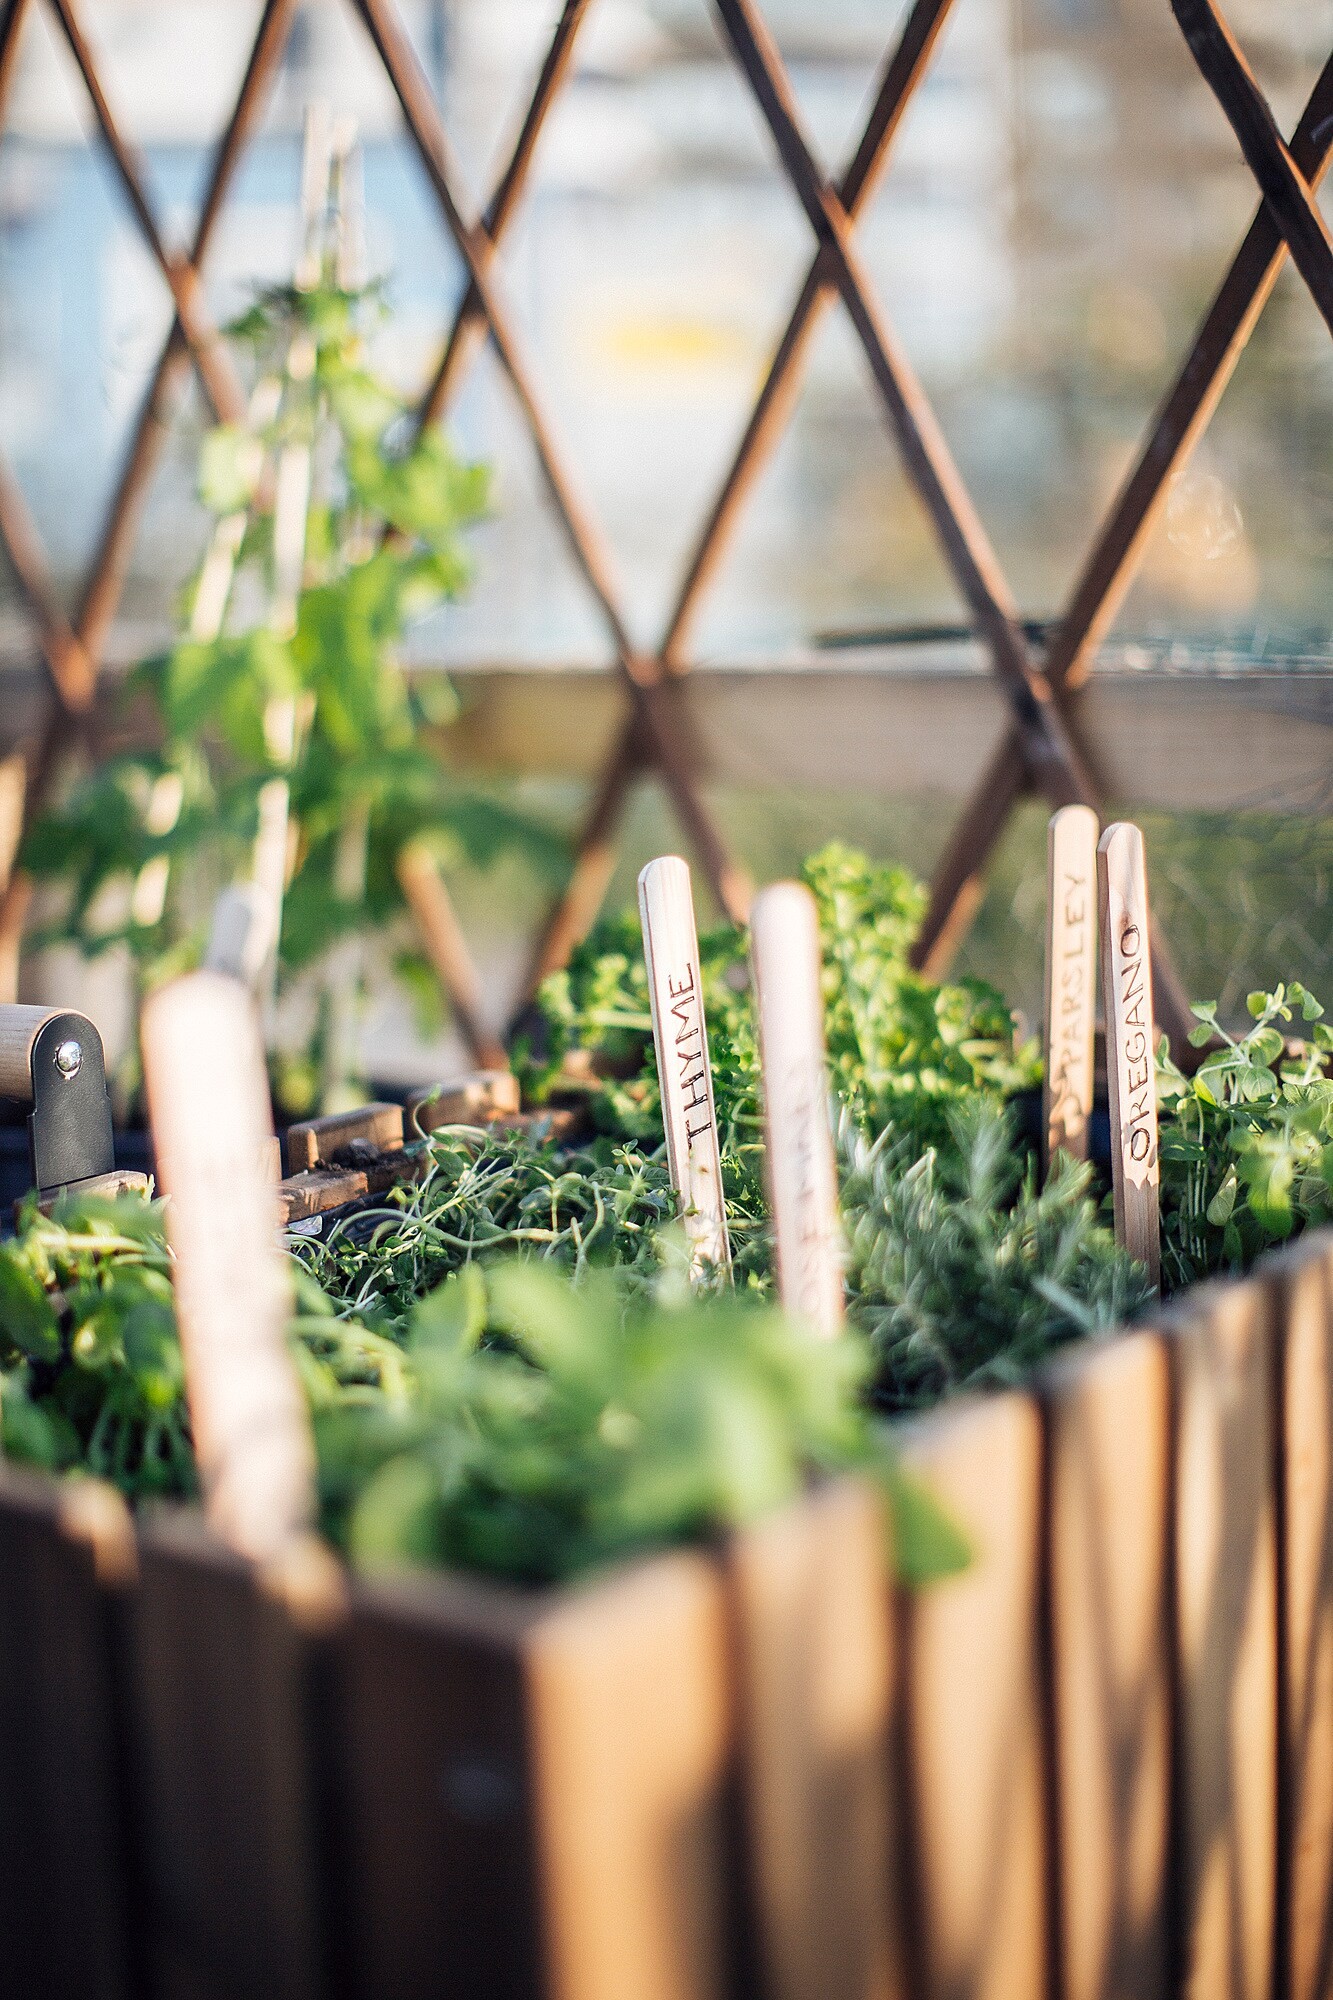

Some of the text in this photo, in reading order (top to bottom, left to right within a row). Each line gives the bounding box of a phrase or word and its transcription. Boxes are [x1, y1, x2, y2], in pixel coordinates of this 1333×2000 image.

[669, 962, 712, 1150] THYME
[1060, 872, 1087, 1068] PARSLEY
[1119, 922, 1152, 1162] OREGANO
